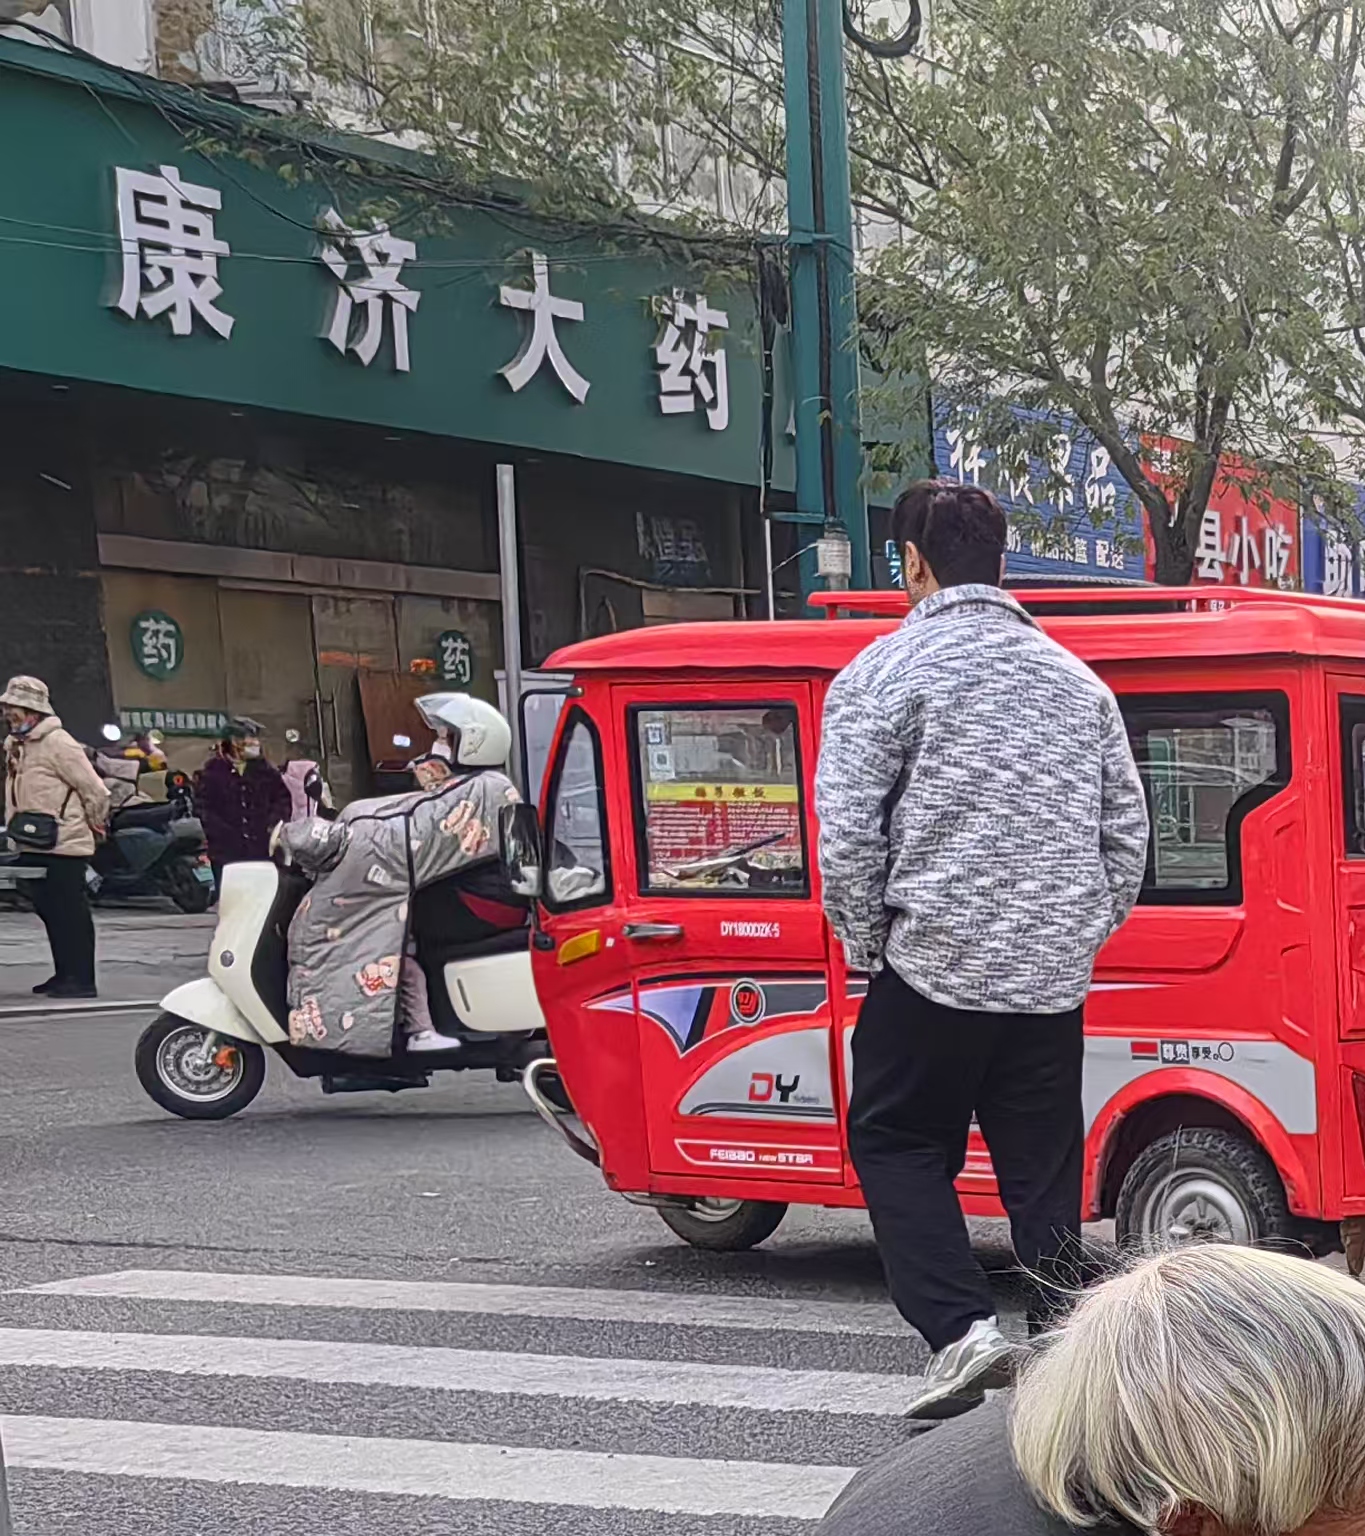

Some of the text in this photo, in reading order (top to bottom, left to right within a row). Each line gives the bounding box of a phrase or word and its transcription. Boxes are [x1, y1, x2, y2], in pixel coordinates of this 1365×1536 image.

[1168, 500, 1293, 586] 县小吃
[140, 618, 176, 669] 药
[442, 636, 471, 684] 药
[748, 1072, 800, 1103] DY
